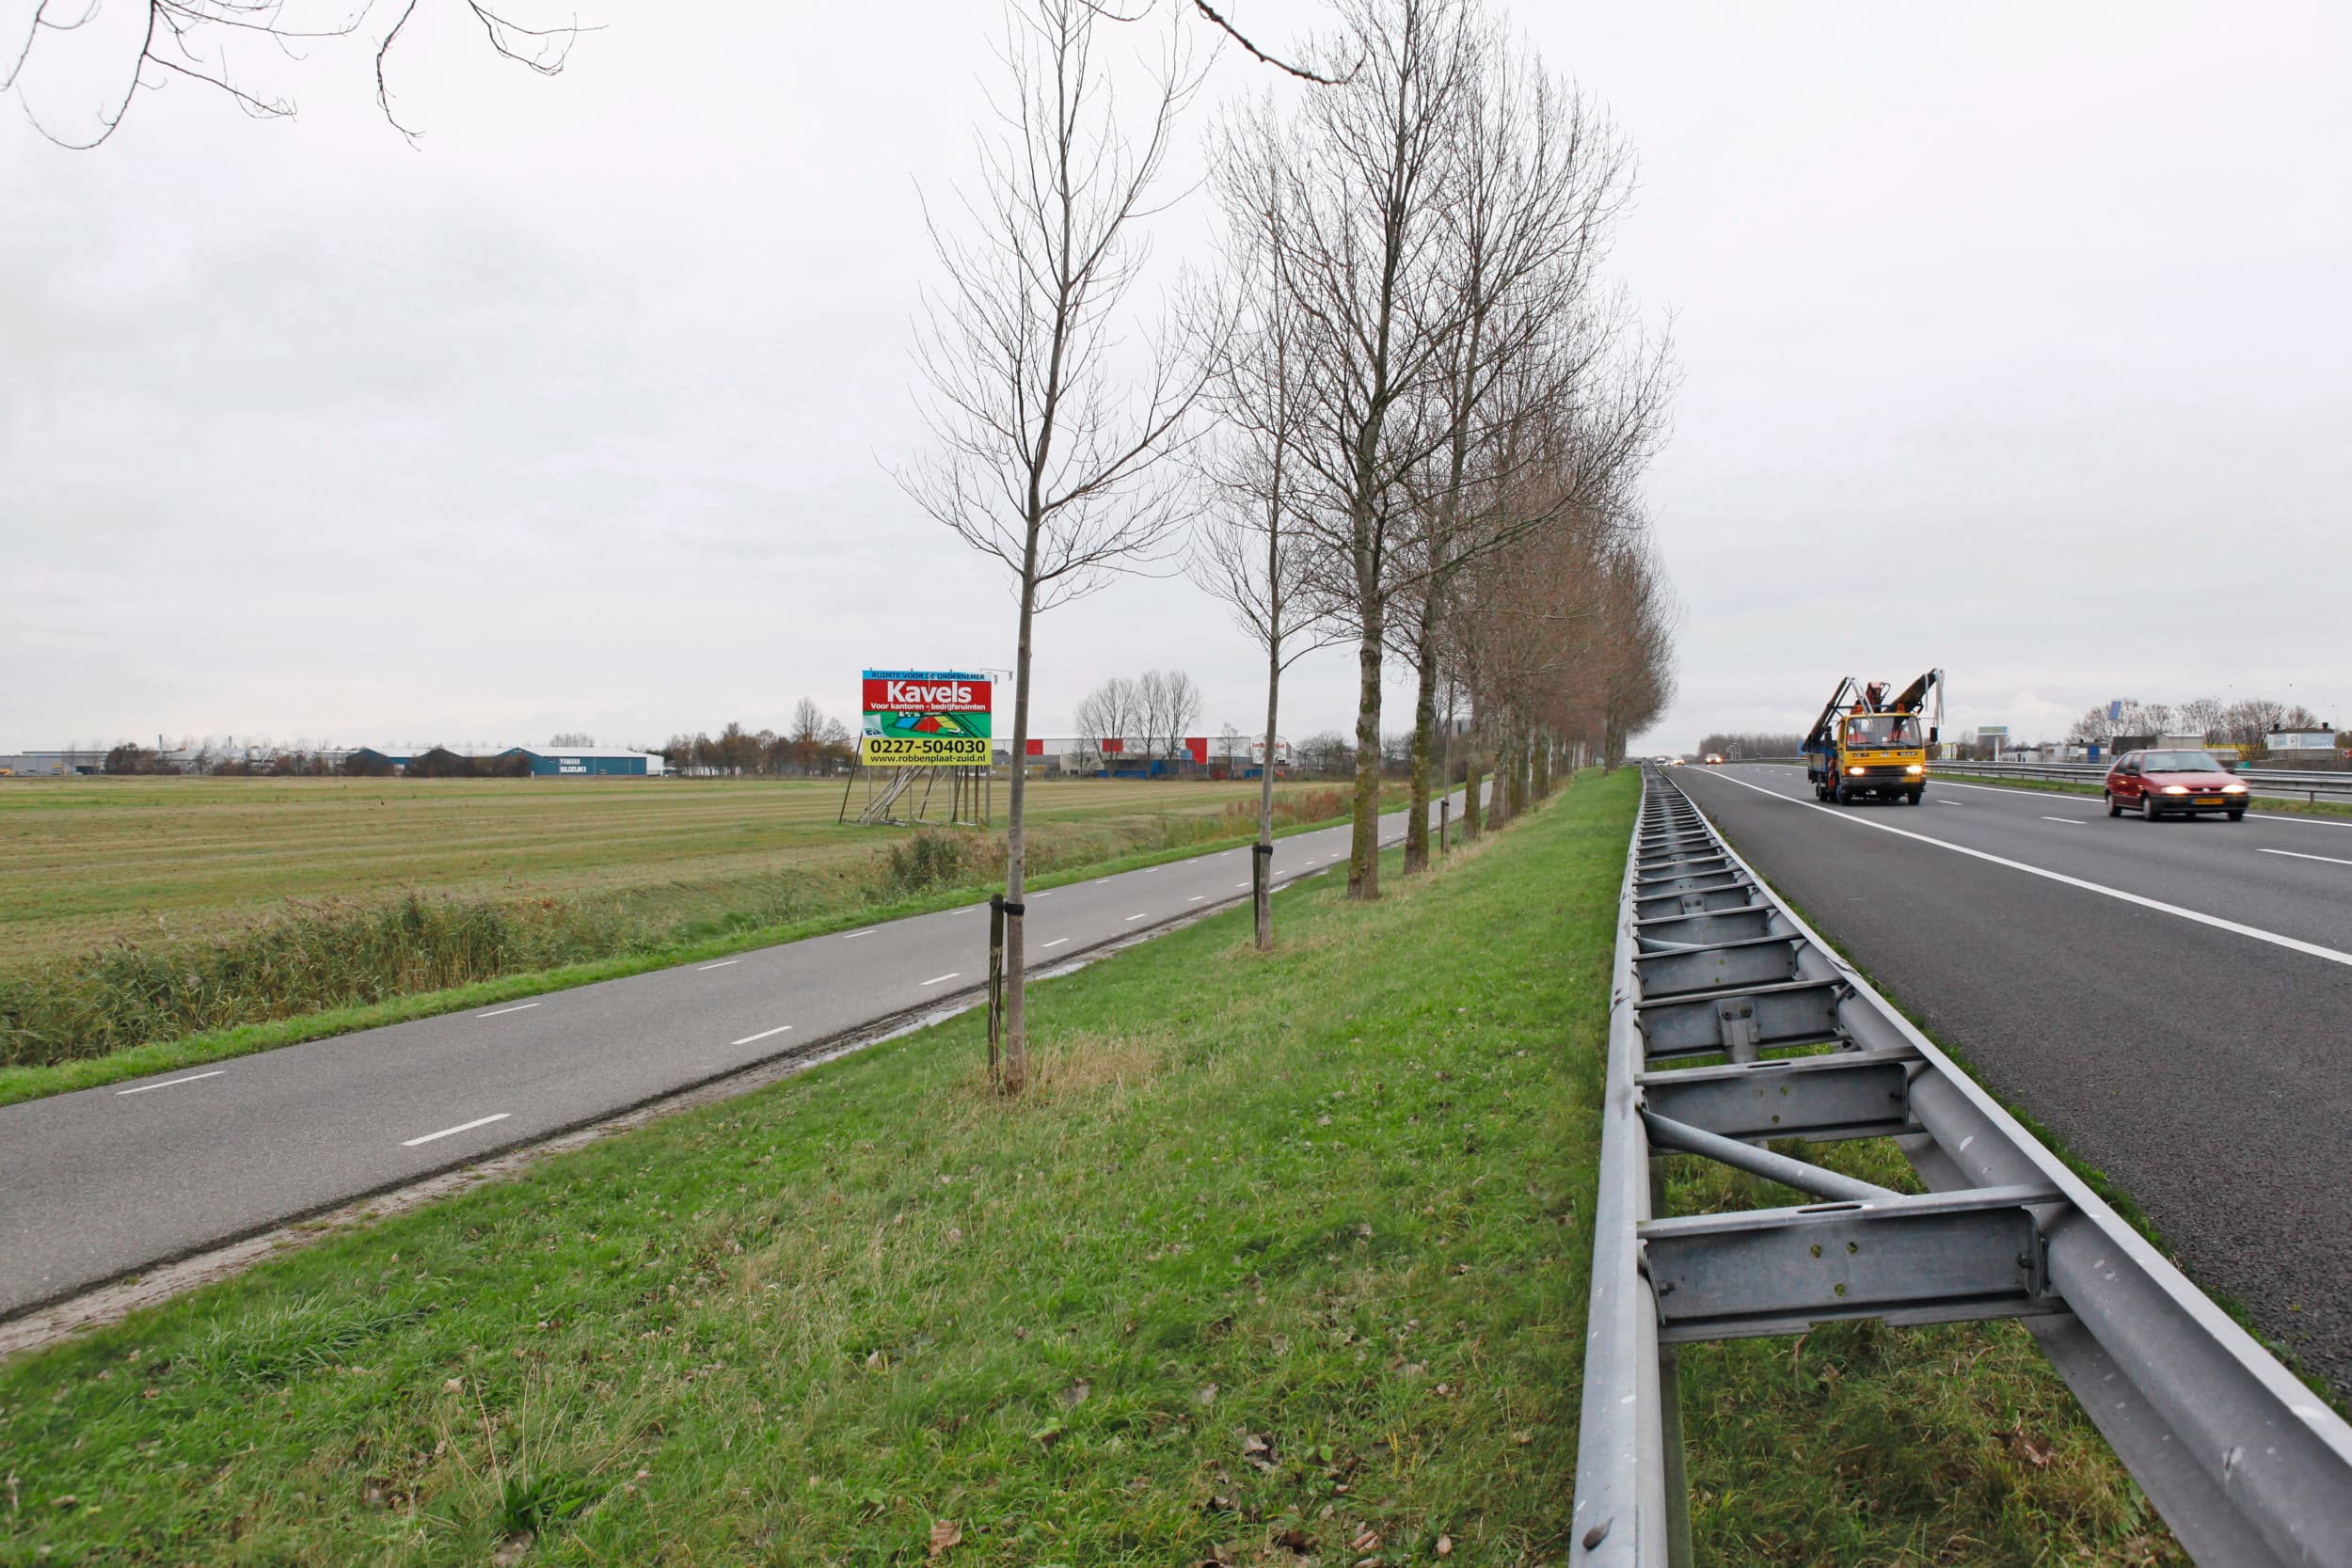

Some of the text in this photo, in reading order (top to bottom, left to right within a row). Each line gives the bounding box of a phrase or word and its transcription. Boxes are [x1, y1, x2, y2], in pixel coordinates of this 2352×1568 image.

[887, 681, 972, 704] Kavels
[870, 740, 985, 753] 0227-504030
[871, 754, 986, 763] www.robbenplaat-zuid.nl
